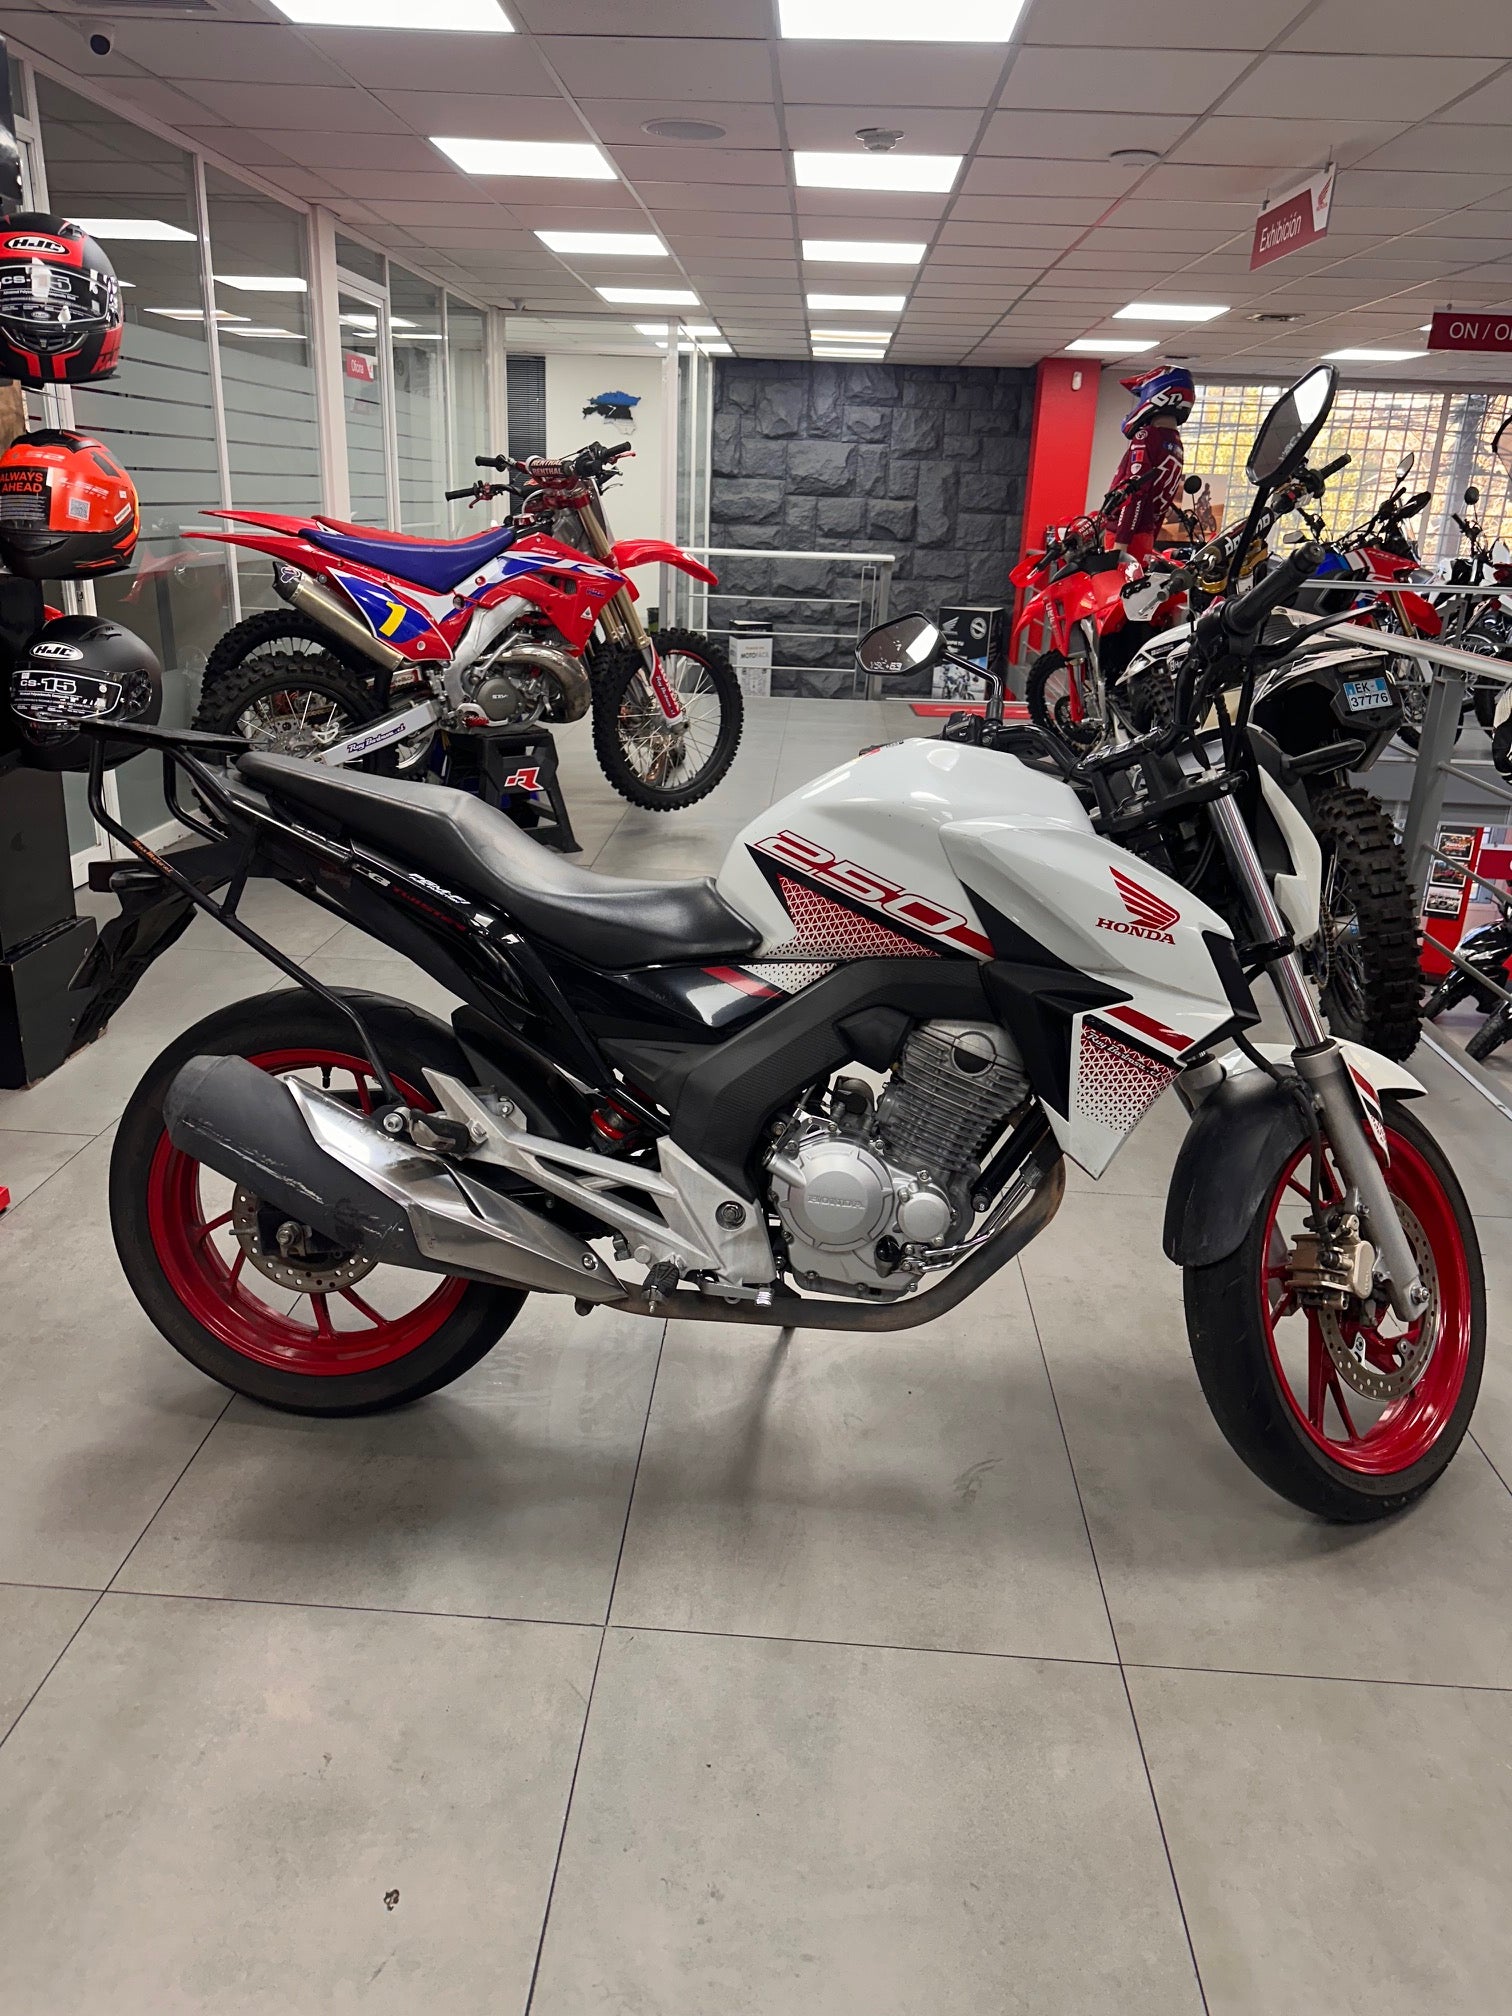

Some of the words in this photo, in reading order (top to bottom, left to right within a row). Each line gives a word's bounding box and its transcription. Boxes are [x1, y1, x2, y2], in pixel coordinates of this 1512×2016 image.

[1259, 211, 1302, 253] Exhibición
[12, 238, 62, 253] HJC
[1449, 321, 1479, 340] ON
[1494, 323, 1512, 341] O
[0, 471, 43, 482] ALWAYS
[2, 482, 43, 492] AHEAD
[379, 601, 407, 637] 1
[35, 645, 74, 657] HJC
[20, 677, 77, 694] CS-15
[1351, 692, 1388, 707] 37776
[754, 829, 968, 935] 250
[1095, 917, 1176, 945] HONDA
[807, 1194, 866, 1210] HONDA
